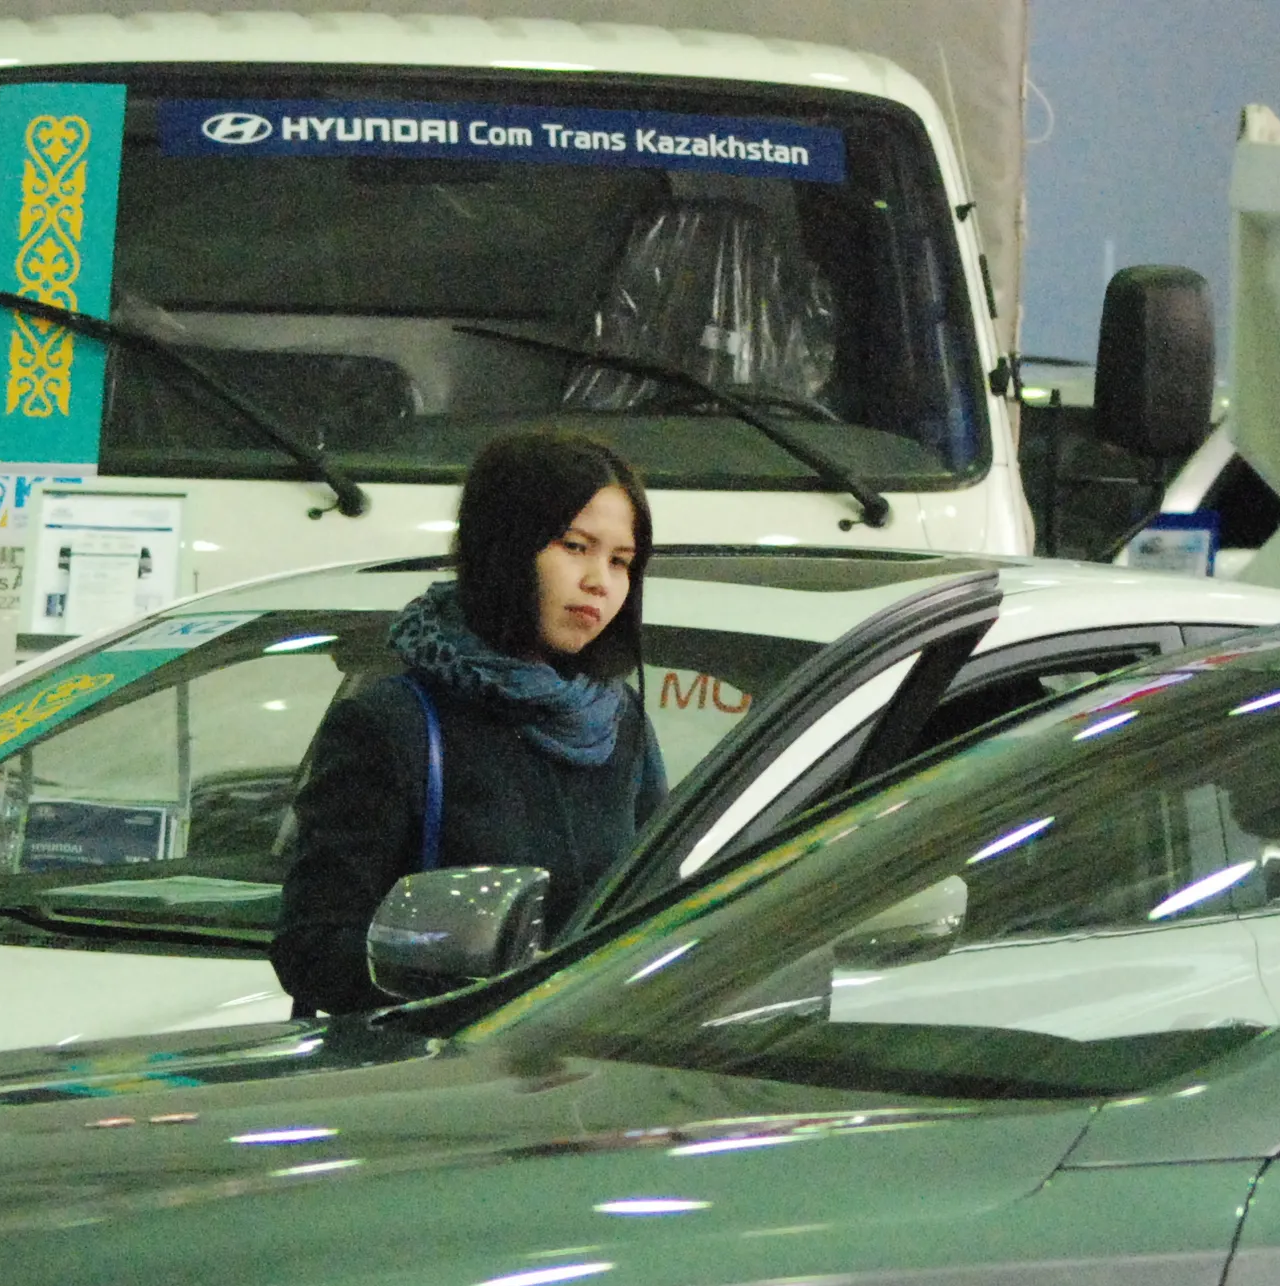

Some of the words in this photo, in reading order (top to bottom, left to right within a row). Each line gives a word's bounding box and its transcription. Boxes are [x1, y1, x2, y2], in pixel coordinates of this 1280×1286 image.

[282, 116, 458, 144] HYUNDAI
[469, 121, 532, 145] Com
[542, 124, 626, 151] Trans
[636, 128, 809, 165] Kazakhstan
